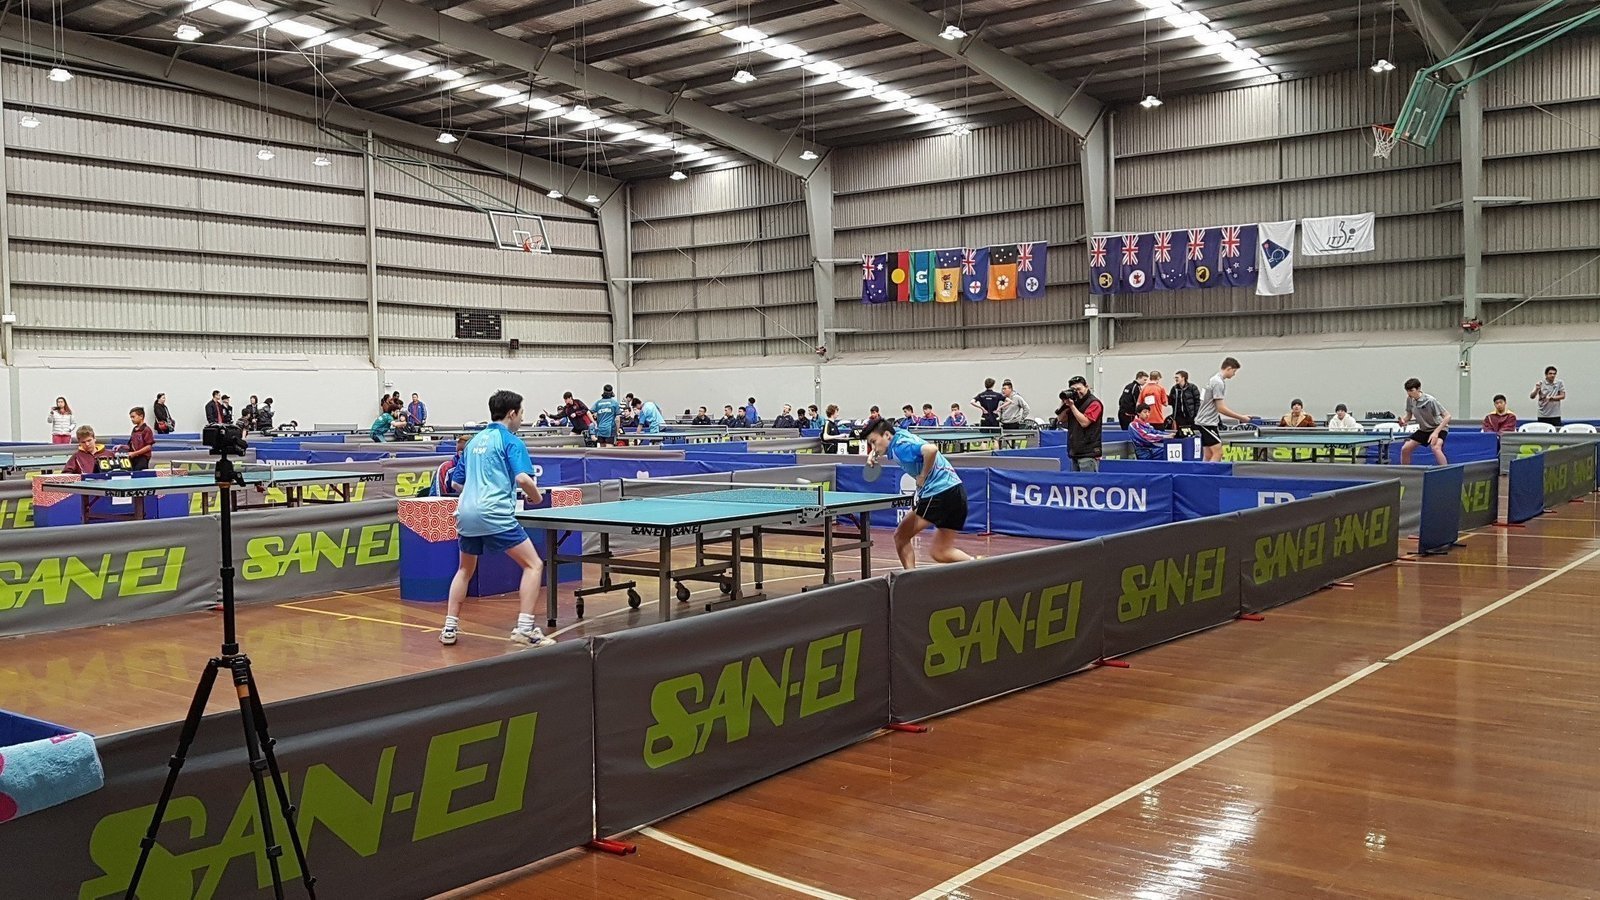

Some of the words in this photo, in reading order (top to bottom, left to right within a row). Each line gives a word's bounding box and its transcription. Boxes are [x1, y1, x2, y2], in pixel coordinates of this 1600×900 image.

[1169, 450, 1181, 459] 10
[1010, 483, 1042, 506] LG
[1046, 485, 1147, 511] AIRCON
[241, 523, 400, 581] SAN-EI
[631, 526, 665, 537] SAN-EI
[1252, 522, 1326, 585] SAN-EI
[1333, 506, 1391, 557] AN-EI
[1117, 547, 1226, 623] SAN-EI
[923, 580, 1084, 678] SAN-EI
[642, 629, 863, 769] SAN-EI
[78, 711, 538, 900] SAN-EI
